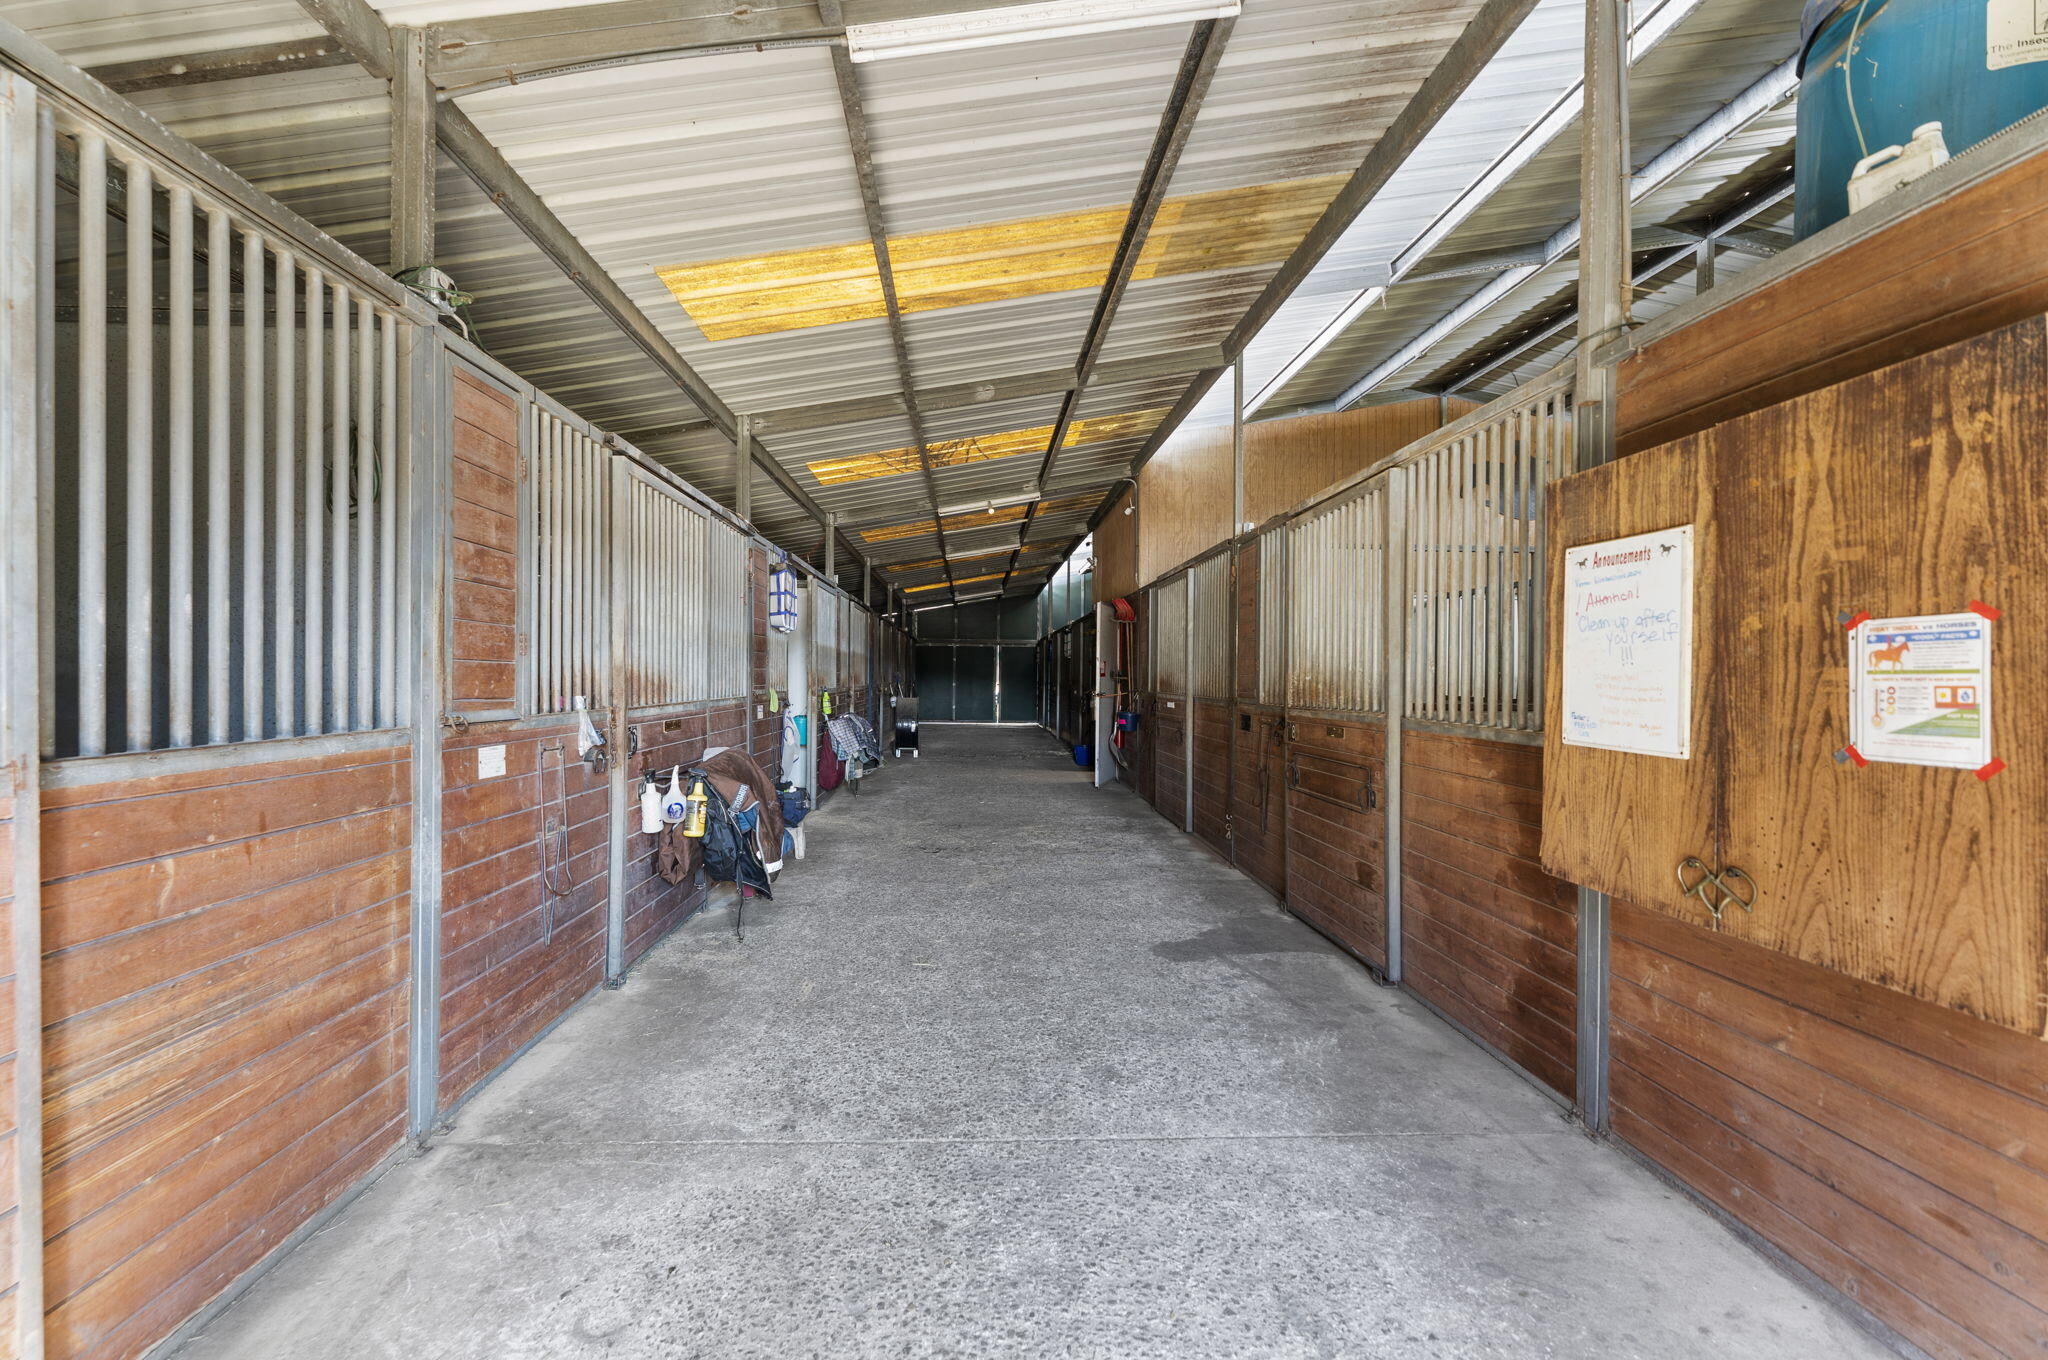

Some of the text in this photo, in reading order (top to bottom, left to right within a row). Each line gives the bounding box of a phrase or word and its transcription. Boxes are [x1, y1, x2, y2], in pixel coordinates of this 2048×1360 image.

[1593, 546, 1652, 569] Announcements
[1578, 608, 1677, 632] Clean up after
[1936, 621, 1977, 629] HORSES
[1606, 623, 1679, 656] yourself
